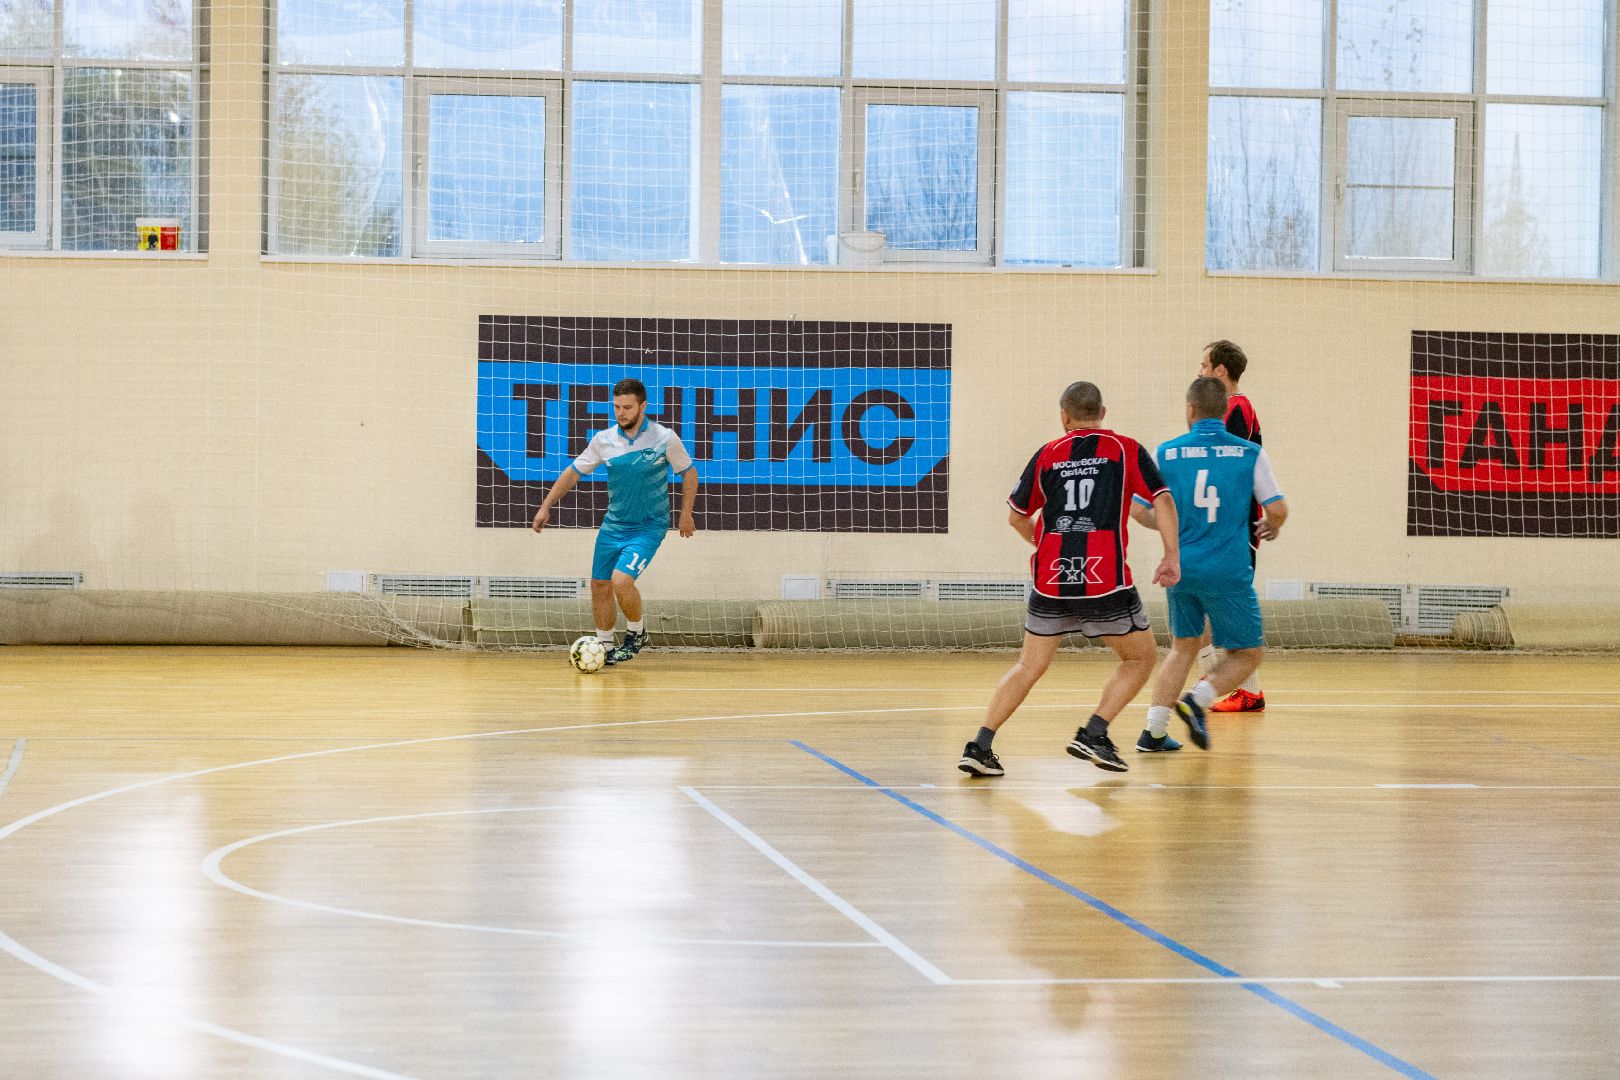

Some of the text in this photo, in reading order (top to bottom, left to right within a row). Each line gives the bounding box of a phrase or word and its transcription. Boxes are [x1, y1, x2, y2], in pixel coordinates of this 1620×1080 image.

[1060, 467, 1099, 478] ОБЛАСТЬ
[1063, 478, 1095, 511] 10
[1194, 469, 1220, 523] 4
